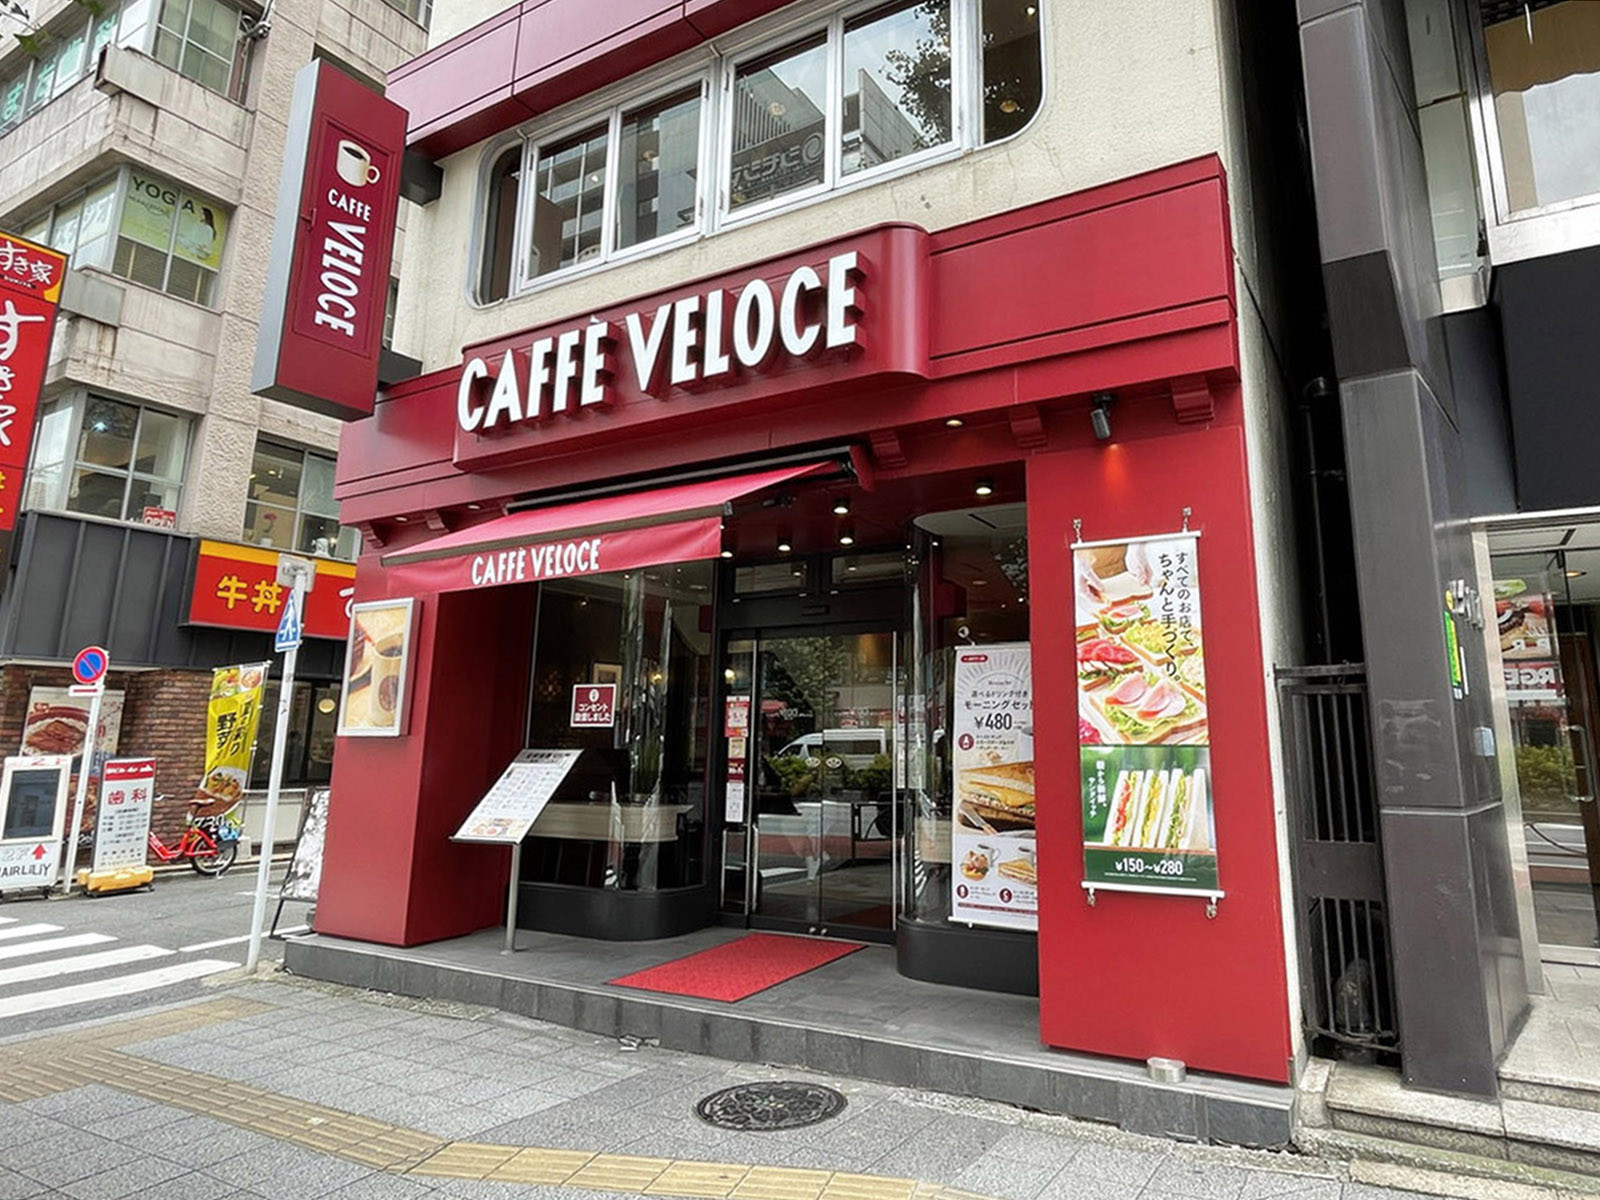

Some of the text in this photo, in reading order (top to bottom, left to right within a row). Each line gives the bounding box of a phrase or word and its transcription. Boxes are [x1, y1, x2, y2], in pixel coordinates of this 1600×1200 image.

[132, 176, 196, 214] YOGA
[0, 241, 53, 285] すき家
[314, 221, 367, 337] VELOCE
[457, 251, 860, 432] CAFFÈ VELOCE
[145, 516, 177, 529] OPEN
[472, 539, 601, 585] CAFFÈ VELOCE
[217, 575, 283, 614] 牛丼
[1175, 552, 1194, 646] すべてのお店で、
[1158, 553, 1181, 682] ちゃんと手づくり。
[578, 703, 608, 712] コンセント
[974, 713, 1013, 731] ¥480
[108, 787, 148, 806] 歯科
